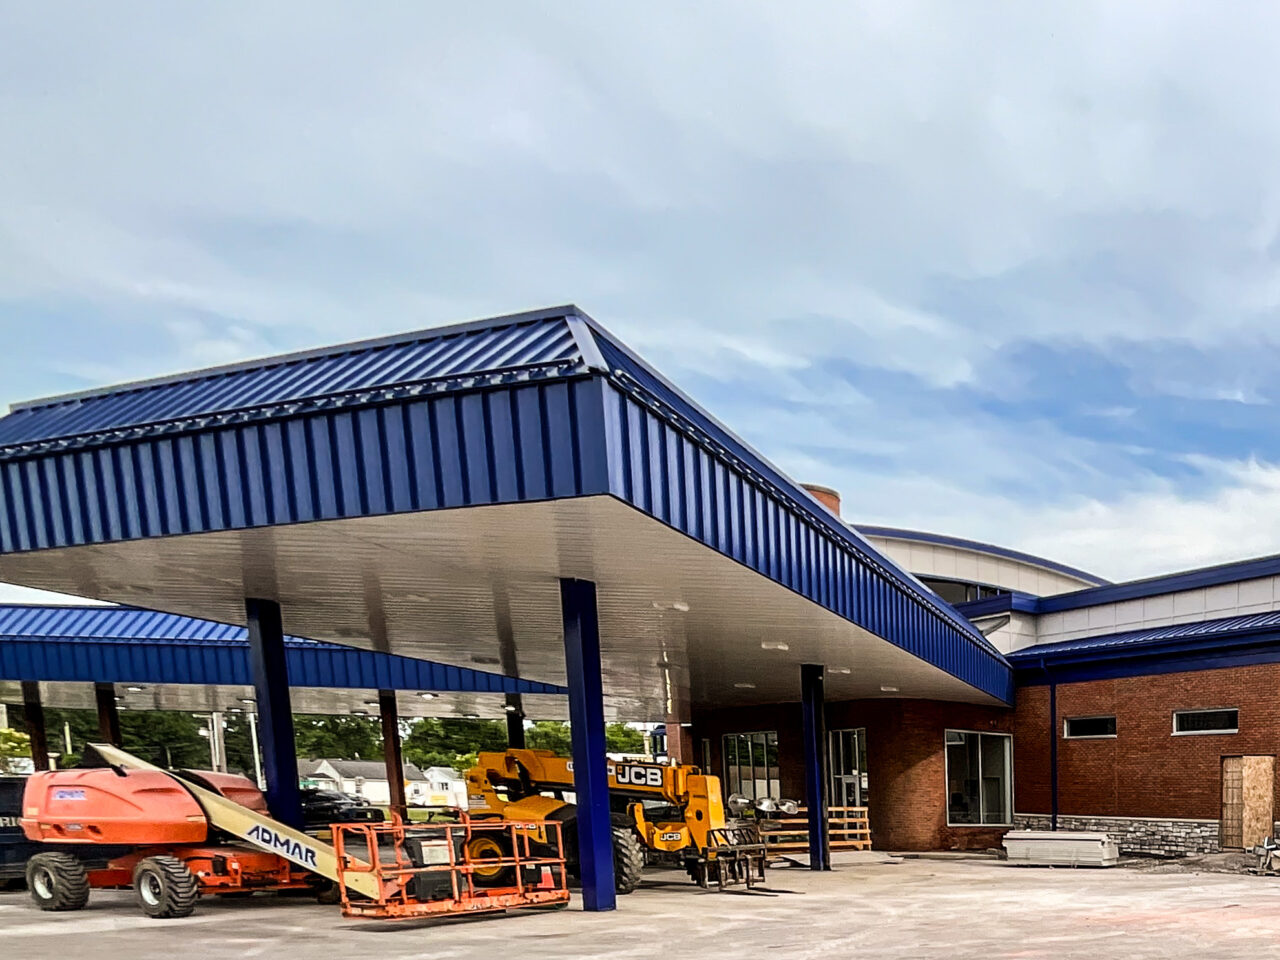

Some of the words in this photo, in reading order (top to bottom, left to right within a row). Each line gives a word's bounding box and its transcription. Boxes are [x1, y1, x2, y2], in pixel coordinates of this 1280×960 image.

[617, 766, 662, 786] JCB
[247, 825, 317, 867] ADMAR
[660, 832, 681, 841] JCB
